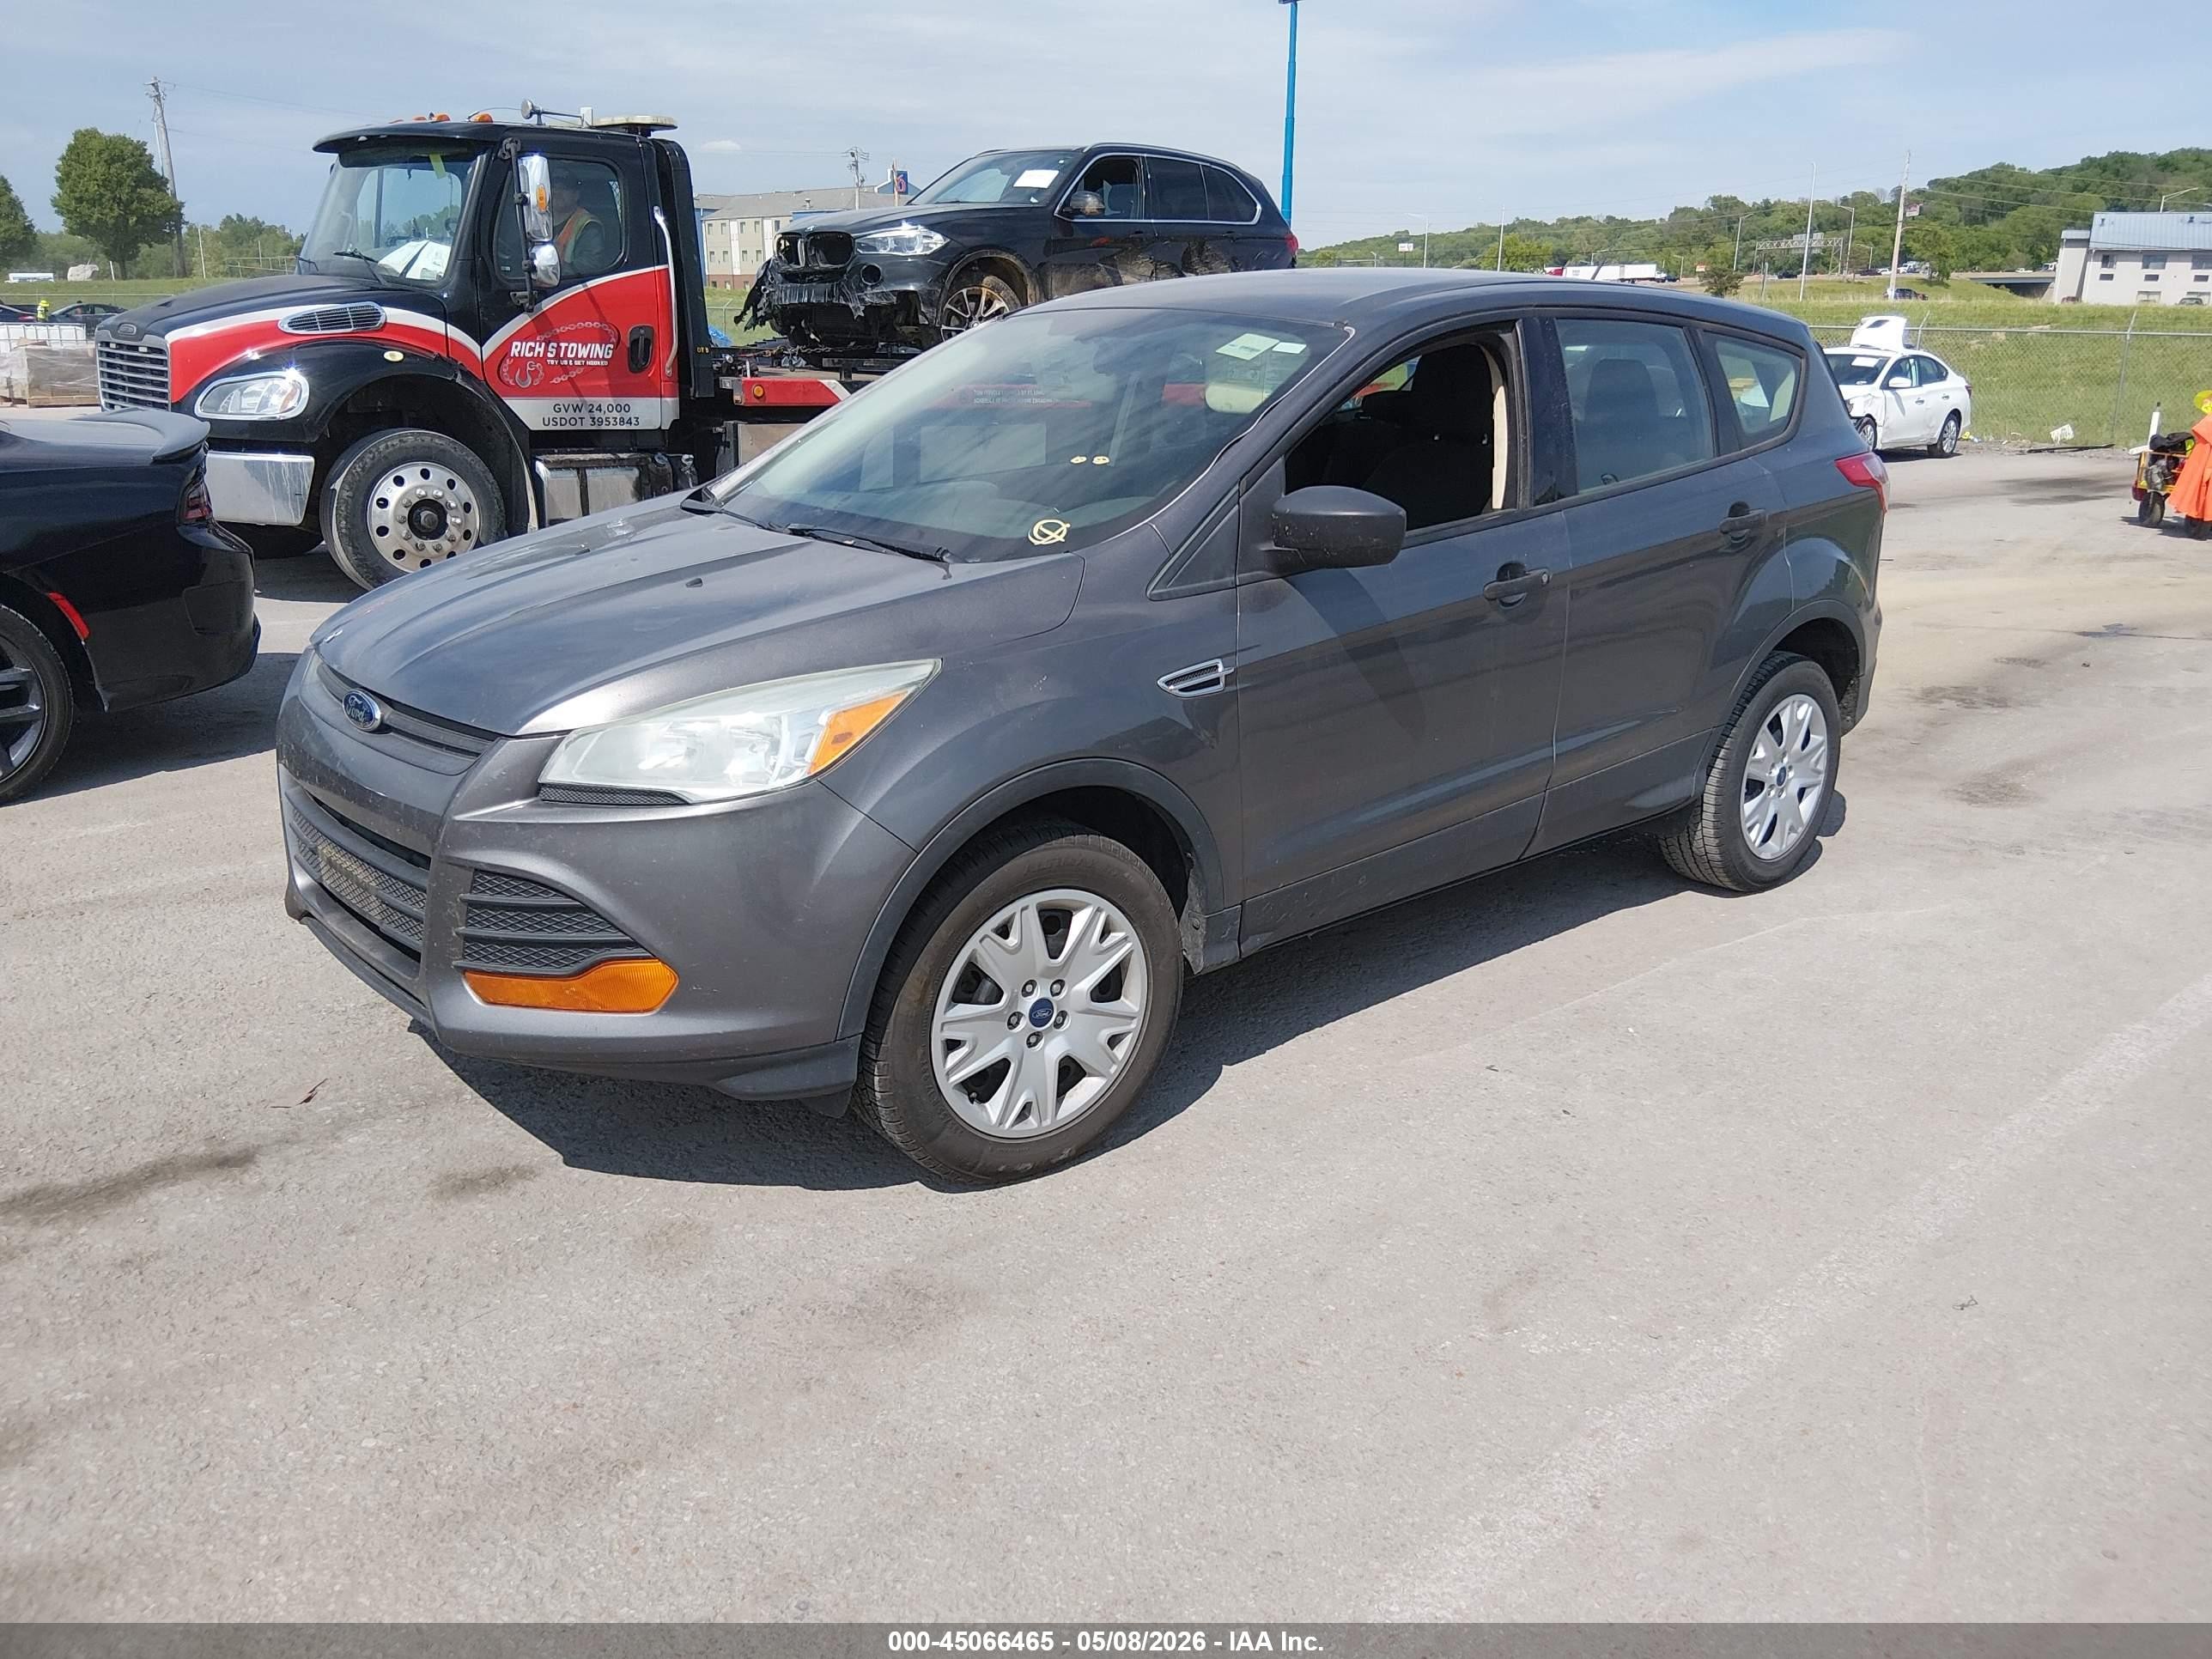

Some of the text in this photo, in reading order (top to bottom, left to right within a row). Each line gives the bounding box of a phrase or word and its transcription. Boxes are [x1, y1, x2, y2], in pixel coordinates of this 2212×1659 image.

[896, 173, 906, 192] 6
[510, 341, 545, 357] RICH
[558, 343, 614, 359] TOWING
[553, 404, 630, 415] GVW 24,000
[542, 416, 640, 427] USDOT 3953843
[345, 695, 367, 722] Ford
